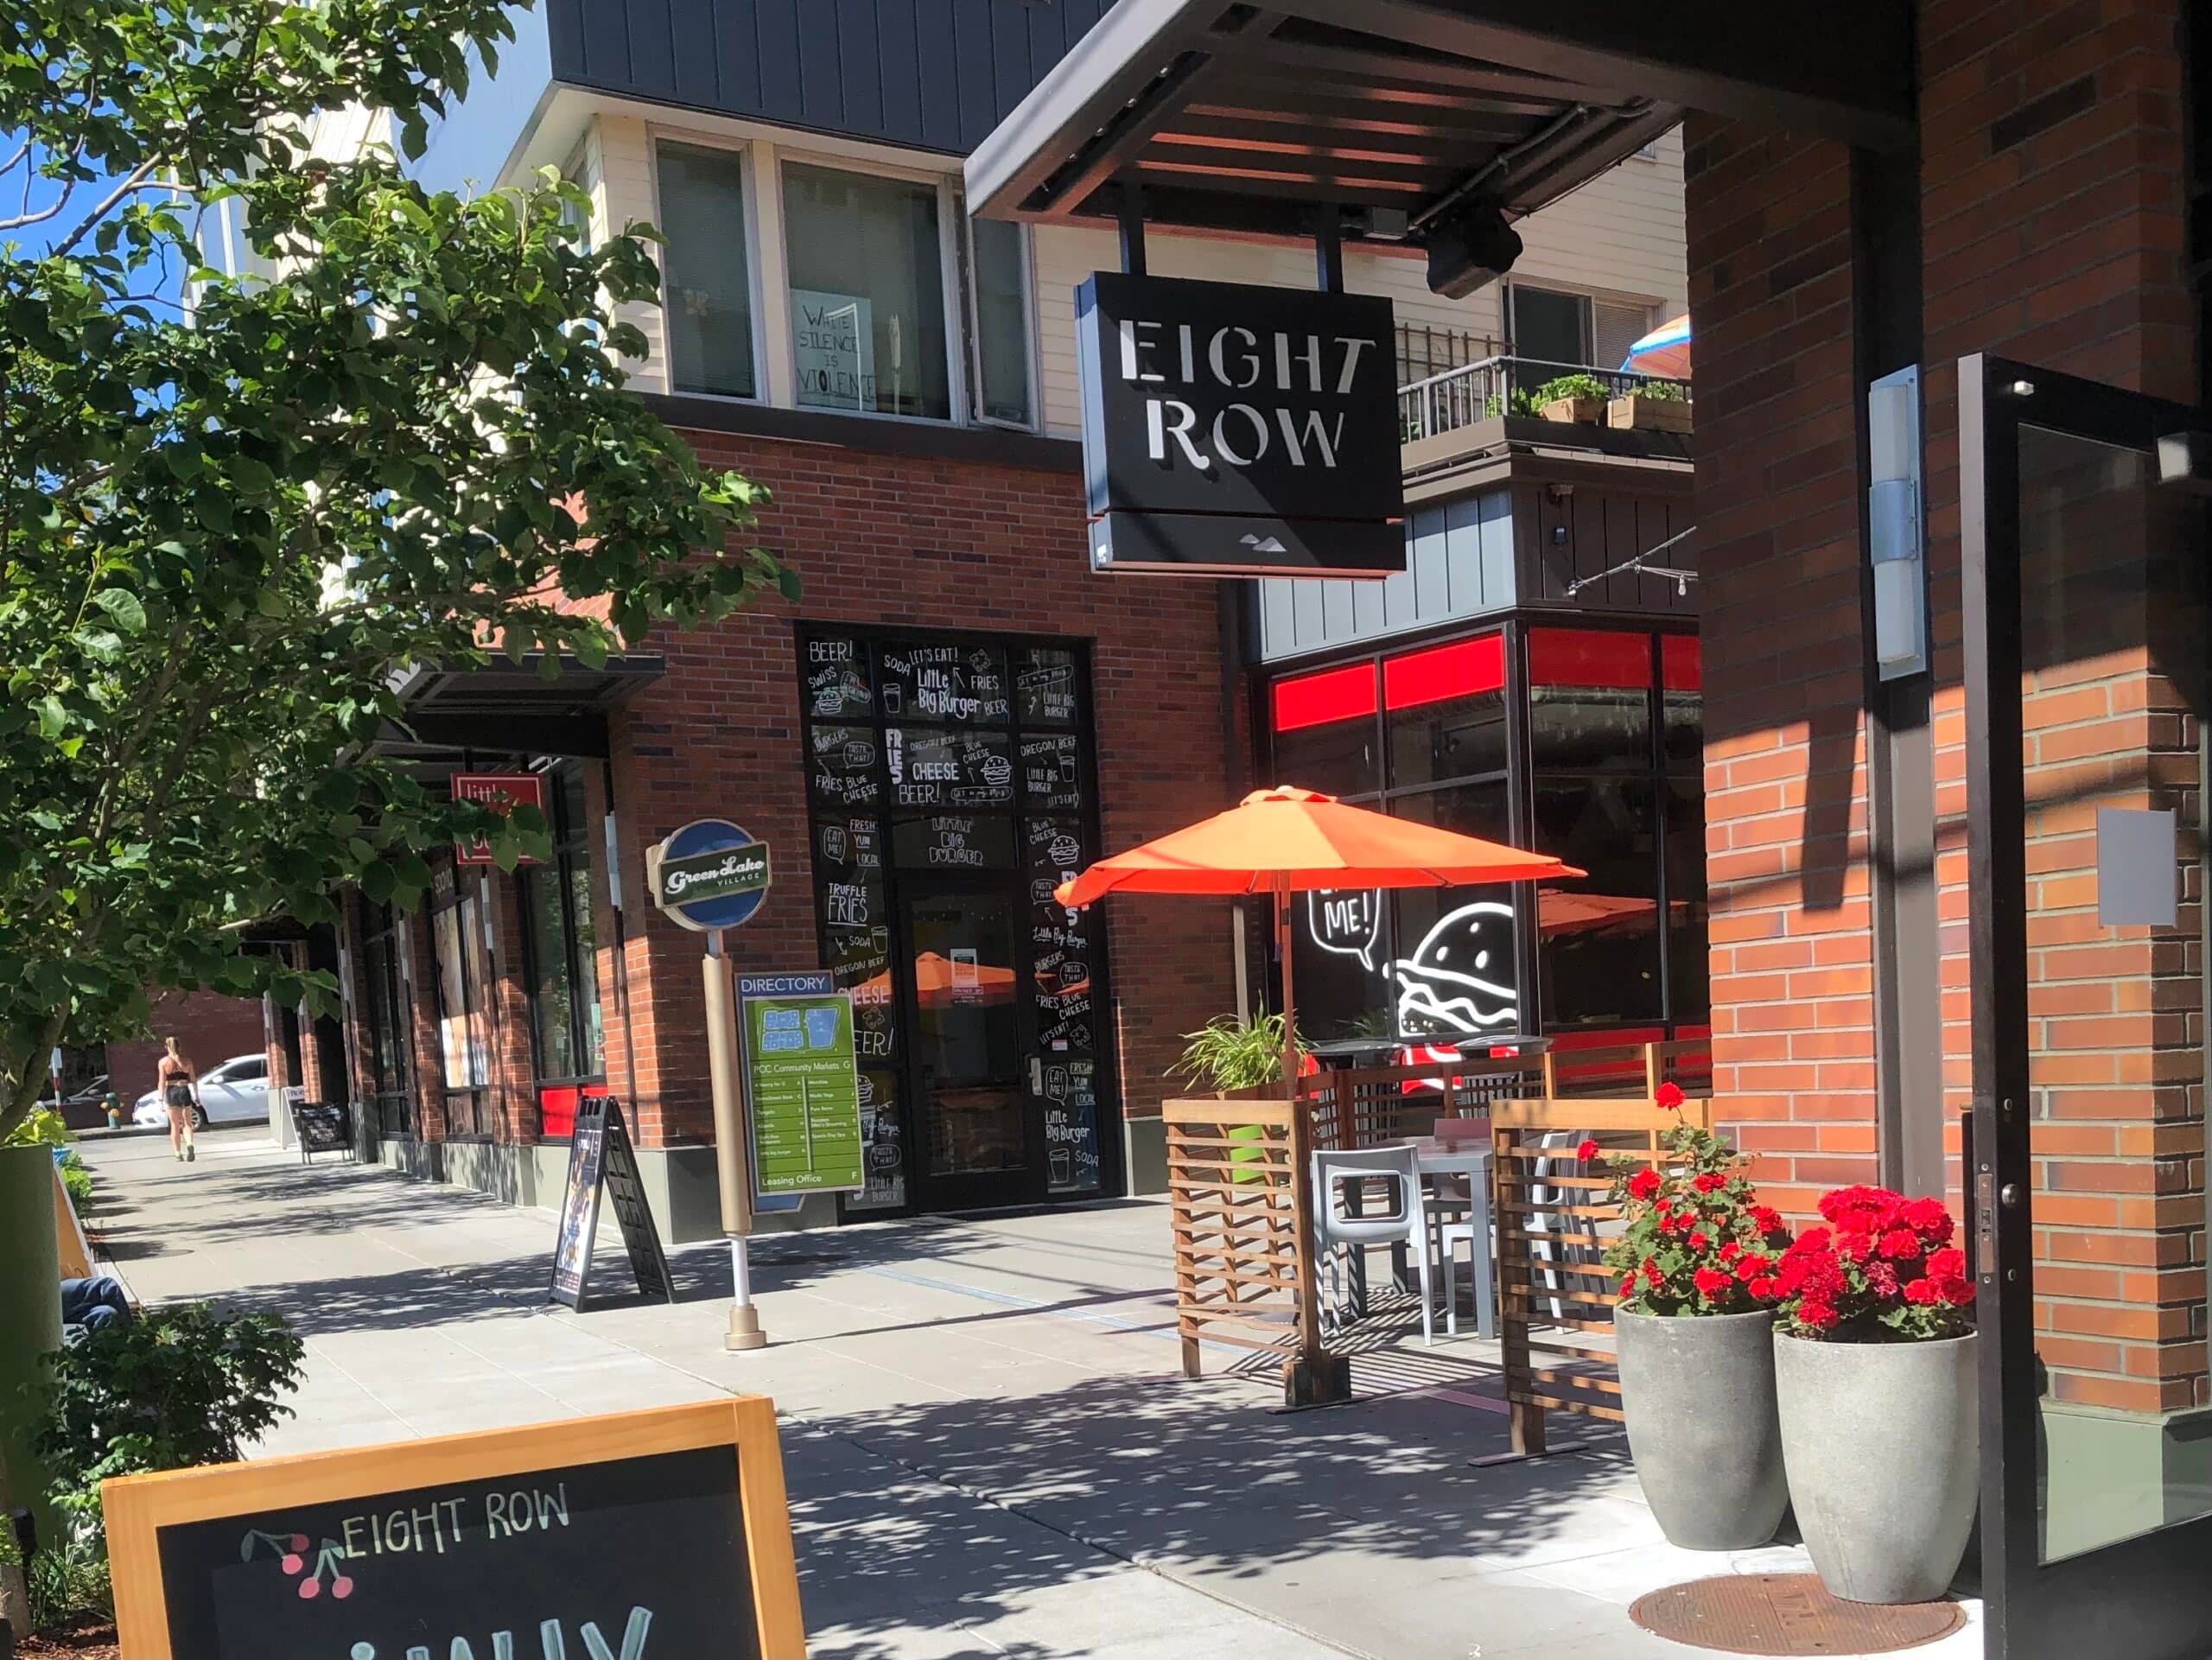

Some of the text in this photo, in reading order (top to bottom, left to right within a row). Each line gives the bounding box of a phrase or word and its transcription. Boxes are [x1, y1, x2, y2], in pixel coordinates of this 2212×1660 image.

[799, 331, 860, 353] SILENCE
[823, 353, 838, 367] IS
[1119, 319, 1376, 395] EIGHT
[797, 366, 877, 399] VIOLENCE
[1146, 398, 1344, 471] ROW
[810, 639, 853, 663] BEER!
[908, 646, 958, 665] LET'S EAT!
[884, 654, 911, 677] SODA
[808, 665, 837, 690] SWISS
[970, 675, 999, 690] FRIES
[938, 690, 982, 720] Burger
[983, 698, 1009, 716] BEER
[1020, 735, 1077, 757] OREGON BEEF
[962, 747, 991, 764] CHEESE
[912, 762, 960, 781] CHEESE
[815, 774, 868, 792] FRIES BLUE
[842, 783, 879, 804] CHEESE
[899, 782, 940, 805] BEER!
[849, 818, 875, 830] FRESH
[827, 829, 842, 843] EAT
[940, 831, 965, 849] BIG
[1029, 828, 1058, 845] CHEESE
[856, 853, 879, 864] LOCAL
[929, 846, 983, 866] BURGER
[664, 855, 765, 894] Green Lake
[716, 872, 760, 887] VILLAGE
[828, 882, 867, 897] TRUFFLE
[828, 894, 868, 923] FRIES
[1324, 893, 1370, 941] ME!
[849, 934, 871, 948] SODA
[834, 956, 886, 976] OREGON BEEF
[741, 976, 826, 992] DIRECTORY
[1035, 993, 1083, 1009] FRIES BLUE
[1058, 1000, 1091, 1021] CHEESE
[753, 1060, 851, 1073] PCC Community Markets G
[1070, 1062, 1093, 1073] FRESH
[1049, 1069, 1065, 1083] EAT
[1046, 1124, 1090, 1143] Big Burger
[1074, 1149, 1099, 1167] SODA
[762, 1174, 823, 1186] Leasing Office
[851, 1171, 857, 1180] F
[340, 1482, 569, 1558] EIGHT ROW
